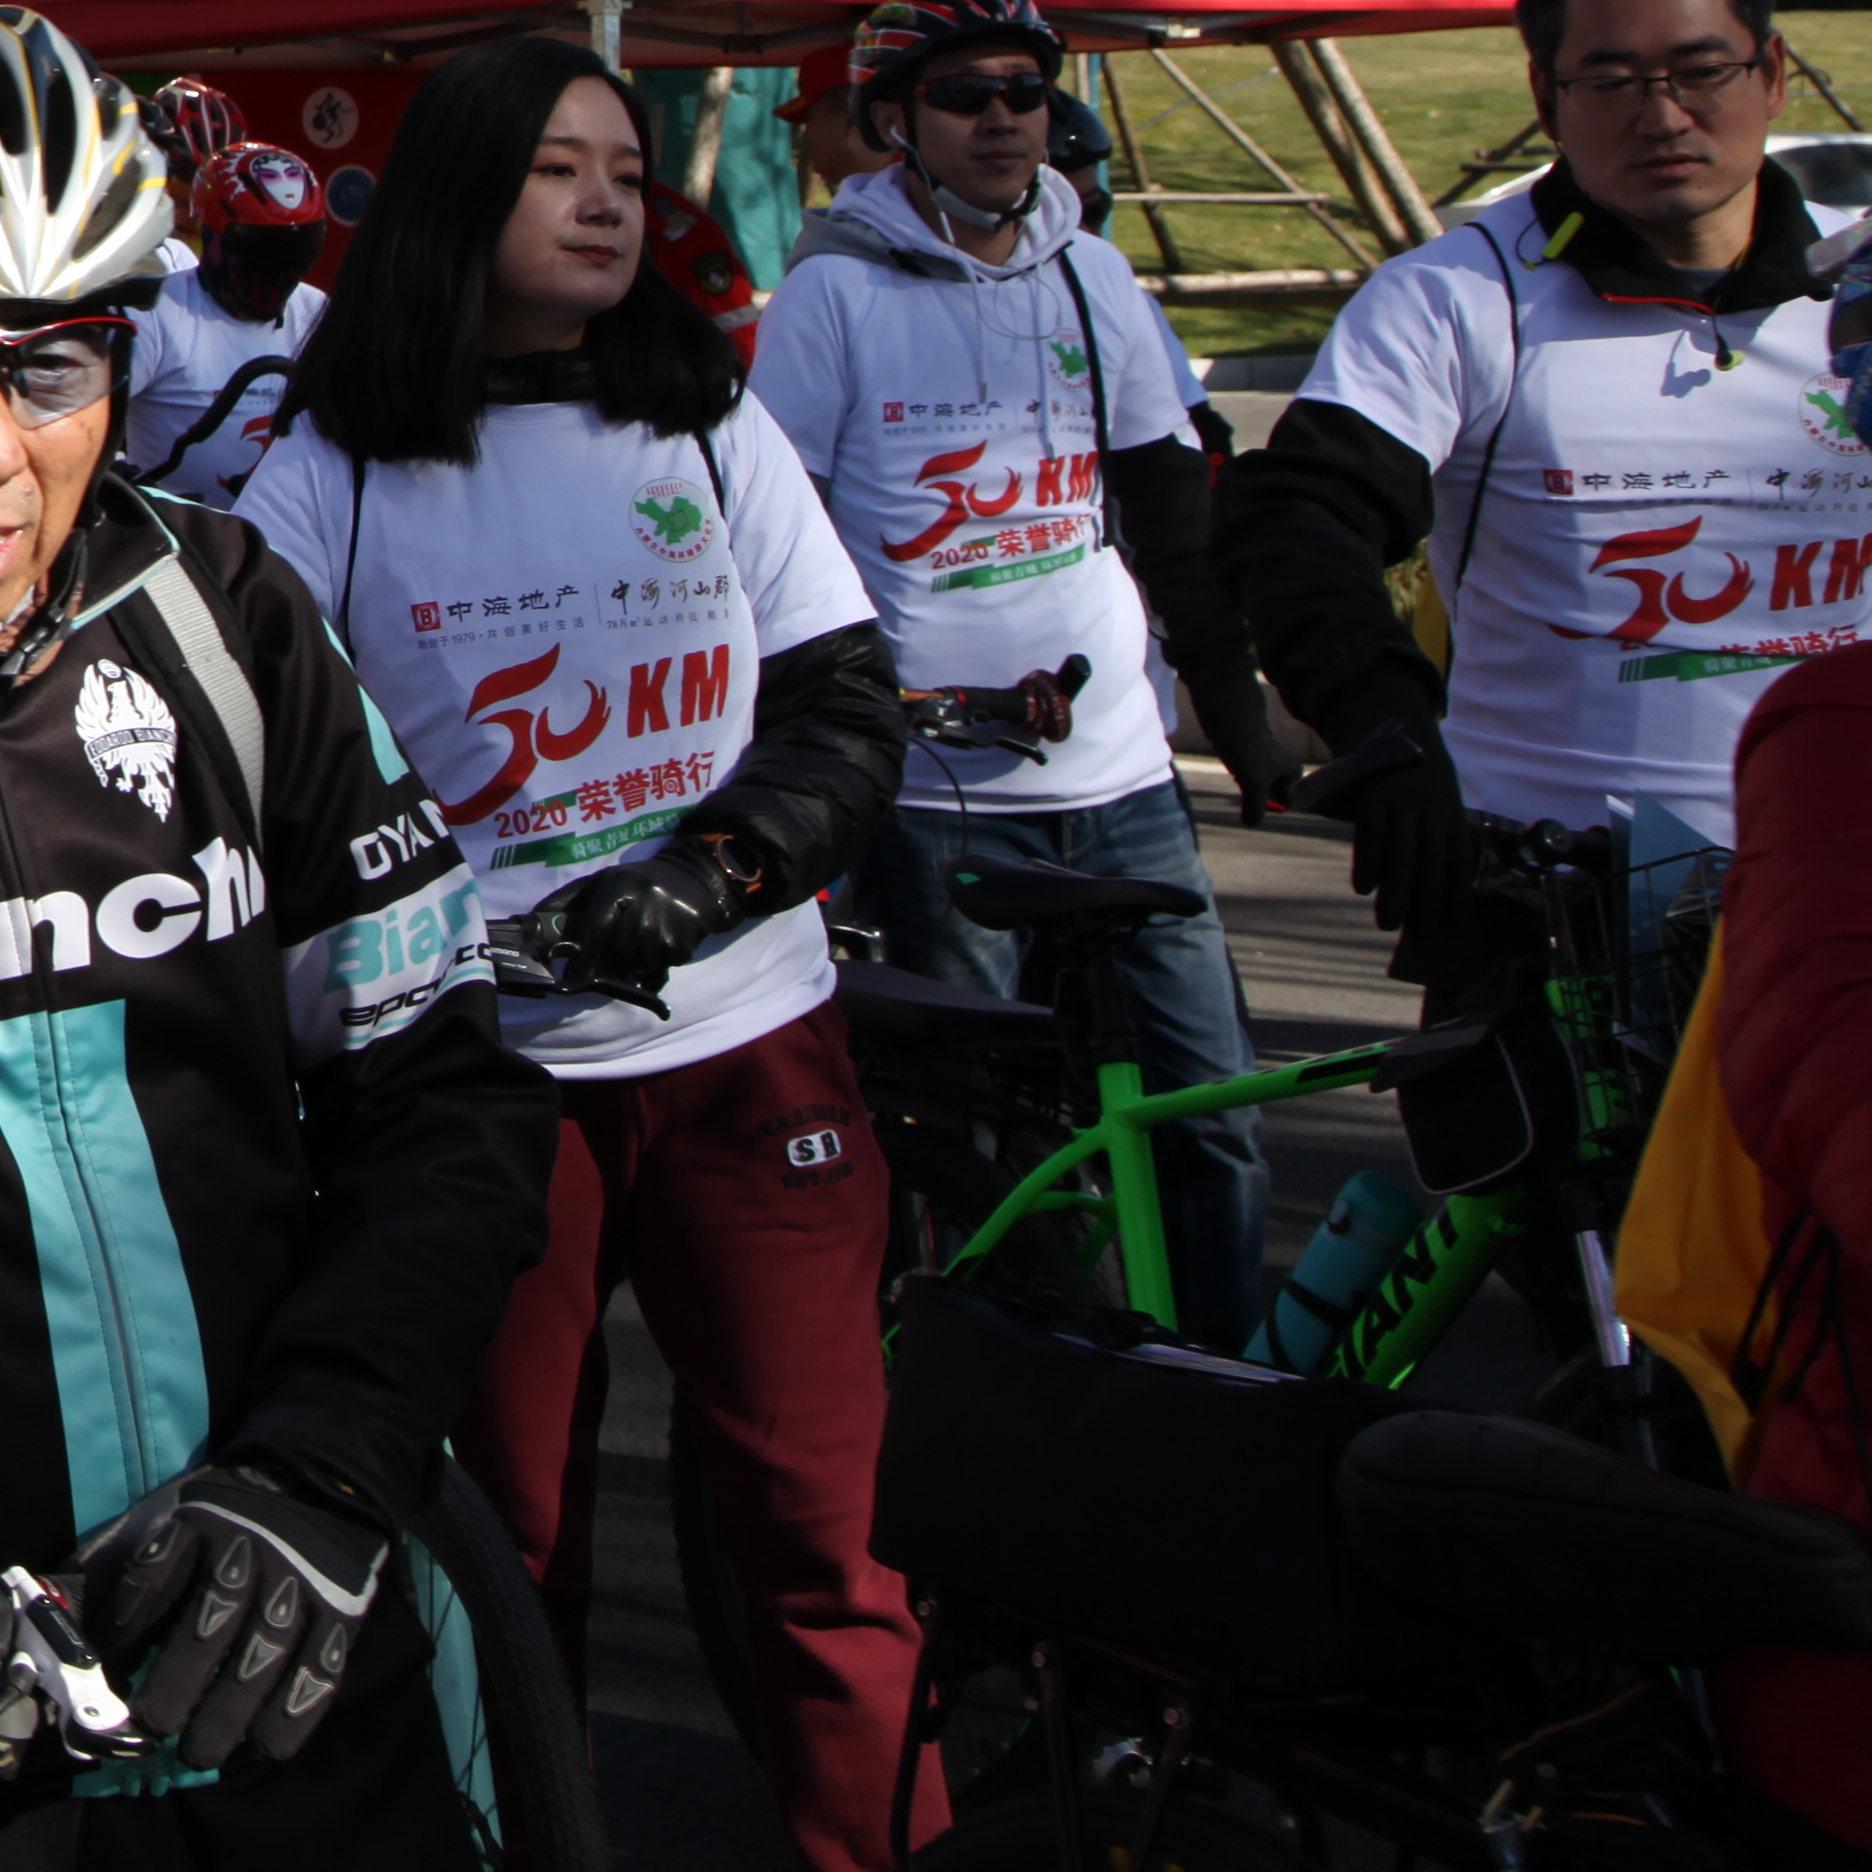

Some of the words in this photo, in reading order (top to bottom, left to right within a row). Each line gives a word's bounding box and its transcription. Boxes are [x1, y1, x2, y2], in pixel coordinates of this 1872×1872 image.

[1581, 469, 1730, 492] 中海地产
[930, 541, 989, 570] 2020
[446, 584, 579, 623] 中海地产
[493, 799, 568, 839] 2020
[575, 750, 715, 823] 荣誉骑行
